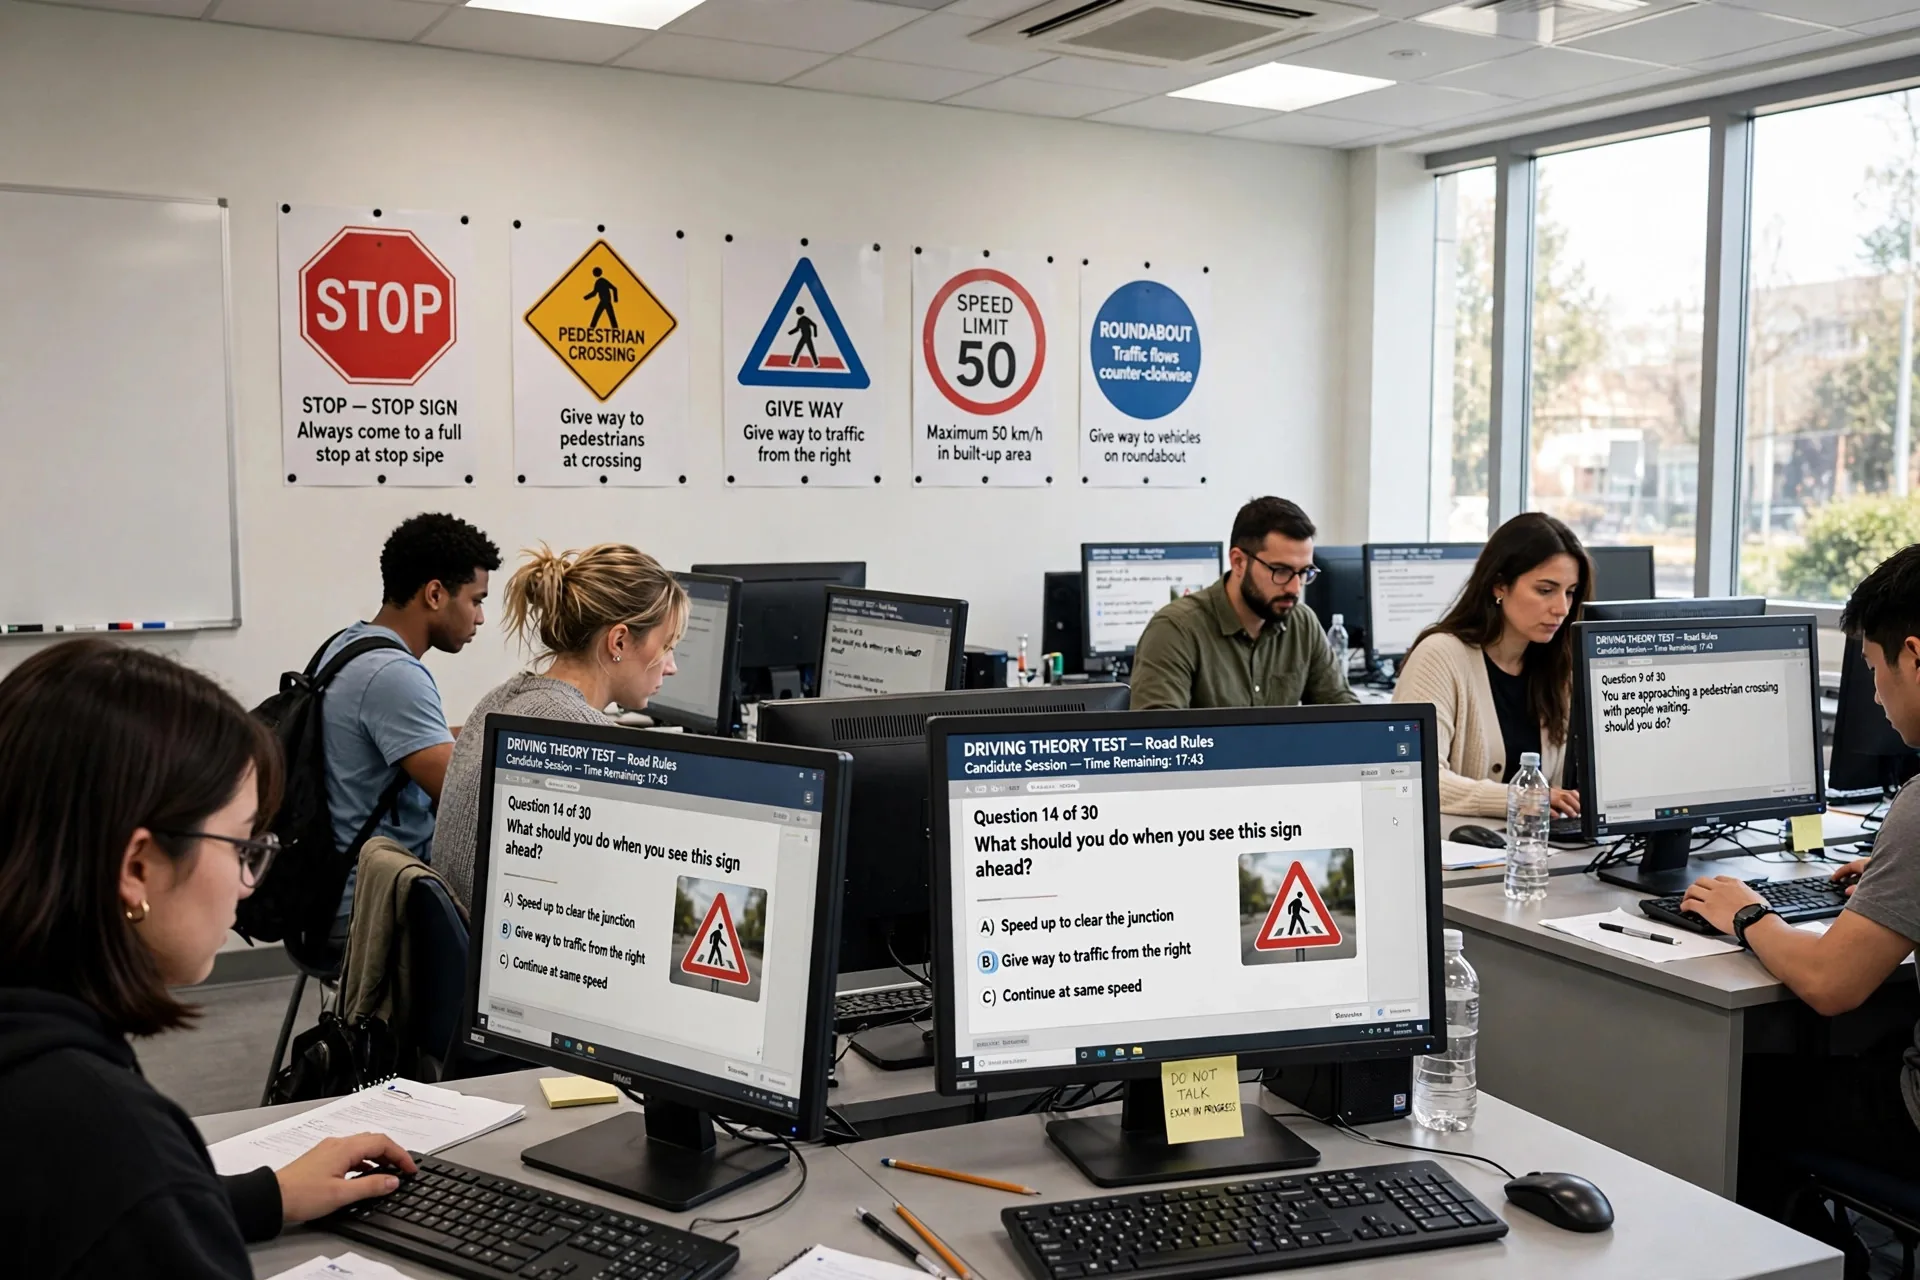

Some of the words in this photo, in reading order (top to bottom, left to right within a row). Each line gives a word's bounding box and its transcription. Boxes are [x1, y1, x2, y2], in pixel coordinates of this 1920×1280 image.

[316, 278, 442, 334] STOP
[957, 294, 1013, 314] SPEED
[963, 317, 1008, 335] LIMIT
[1100, 321, 1192, 342] ROUNDABOUT
[559, 328, 645, 345] PEDESTRIAN
[569, 346, 635, 362] CROSSING
[957, 340, 1016, 388] 50
[1112, 345, 1148, 362] Traffic
[1150, 347, 1179, 364] flows
[302, 396, 347, 414] STOP
[372, 398, 414, 415] STOP
[420, 399, 457, 416] SIGN
[765, 400, 804, 417] GIVE
[808, 401, 843, 418] WAY
[560, 408, 592, 425] Give
[597, 413, 625, 429] way
[630, 411, 644, 425] to
[297, 421, 353, 442] Always
[358, 427, 400, 439] come
[404, 425, 420, 440] to
[425, 428, 433, 440] a
[438, 423, 461, 440] full
[560, 431, 644, 450] pedestrians
[743, 424, 774, 440] Give
[778, 429, 804, 444] way
[808, 427, 822, 441] to
[825, 425, 864, 441] traffic
[927, 424, 988, 440] Maximum
[992, 426, 1007, 440] 50
[1011, 426, 1042, 441] km/h
[1089, 428, 1114, 443] Give
[1118, 433, 1140, 447] way
[1143, 431, 1154, 443] to
[1158, 429, 1200, 444] vehicles
[316, 446, 350, 466] stop
[355, 447, 370, 462] at
[375, 447, 408, 466] stop
[413, 446, 444, 466] sipe
[563, 453, 577, 467] at
[581, 453, 641, 472] crossing
[758, 445, 790, 462] from
[794, 446, 815, 462] the
[820, 447, 851, 466] right
[938, 444, 949, 460] in
[954, 445, 1001, 464] built-up
[1005, 450, 1031, 461] area
[1104, 452, 1118, 462] on
[1122, 448, 1185, 463] roundabout
[1627, 634, 1656, 643] THEORY
[1658, 633, 1674, 642] TEST
[1601, 673, 1636, 686] Question
[1638, 672, 1643, 682] 9
[1645, 672, 1654, 682] of
[1656, 672, 1665, 682] 30
[1601, 690, 1618, 701] You
[1621, 691, 1635, 700] are
[1638, 685, 1690, 702] approaching
[1692, 688, 1697, 696] a
[1700, 683, 1743, 699] pedestrian
[1745, 681, 1778, 694] crossing
[1603, 704, 1622, 717] with
[1624, 703, 1654, 719] people
[1656, 701, 1690, 715] waiting.
[1605, 719, 1634, 732] should
[1637, 721, 1652, 733] you
[1655, 717, 1671, 729] do?
[507, 737, 546, 754] DRIVING
[549, 742, 589, 759] THEORY
[591, 748, 616, 762] TEST
[627, 753, 650, 767] Road
[652, 756, 677, 771] Rules
[964, 740, 1026, 757] DRIVING
[1029, 738, 1089, 754] THEORY
[1092, 737, 1127, 752] TEST
[1145, 735, 1177, 749] Road
[1180, 735, 1214, 748] Rules
[1025, 759, 1067, 771] Session
[1083, 757, 1110, 769] Time
[1113, 754, 1172, 769] Remaining:
[1175, 753, 1204, 765] 17:43
[508, 795, 549, 814] Question
[553, 802, 563, 816] 14
[566, 804, 577, 818] of
[578, 805, 591, 820] 30
[974, 808, 1037, 827] Question
[1042, 806, 1059, 821] 14
[1063, 804, 1077, 820] of
[1081, 805, 1098, 820] 30
[507, 818, 533, 836] What
[536, 824, 571, 842] should
[573, 832, 593, 847] you
[596, 833, 609, 848] do
[613, 836, 641, 854] when
[644, 844, 664, 859] you
[668, 848, 687, 862] see
[691, 848, 712, 866] this
[715, 852, 740, 873] sign
[974, 835, 1016, 852] What
[1021, 831, 1072, 850] should
[1076, 835, 1104, 851] you
[1109, 828, 1129, 846] do
[1132, 827, 1173, 844] when
[1177, 829, 1204, 846] you
[1209, 828, 1234, 841] see
[1238, 823, 1266, 839] this
[1270, 822, 1301, 841] sign
[505, 842, 543, 859] ahead?
[976, 858, 1032, 877] ahead?
[517, 893, 542, 910] Speed
[566, 904, 586, 918] clear
[588, 908, 600, 922] the
[600, 910, 635, 928] junction
[1001, 916, 1037, 935] Speed
[1041, 919, 1056, 933] up
[1059, 916, 1071, 928] to
[1074, 913, 1103, 927] clear
[1105, 911, 1124, 925] the
[1127, 909, 1174, 928] junction
[515, 925, 533, 940] Give
[535, 933, 551, 947] way
[563, 936, 586, 952] traffic
[588, 940, 608, 956] from
[610, 945, 623, 960] the
[625, 949, 645, 965] right
[1002, 953, 1029, 967] Give
[1032, 954, 1055, 968] way
[1058, 951, 1071, 963] to
[1073, 946, 1109, 962] traffic
[1111, 945, 1139, 959] from
[1142, 943, 1161, 957] the
[1164, 941, 1191, 959] right
[513, 956, 548, 975] Continue
[559, 969, 581, 983] same
[582, 975, 608, 989] speed
[1003, 986, 1055, 1002] Continue
[1059, 985, 1070, 998] at
[1074, 985, 1104, 997] same
[1107, 978, 1142, 997] speed
[1171, 1072, 1186, 1085] DO
[1193, 1067, 1217, 1082] NOT
[1177, 1087, 1210, 1100] TALK
